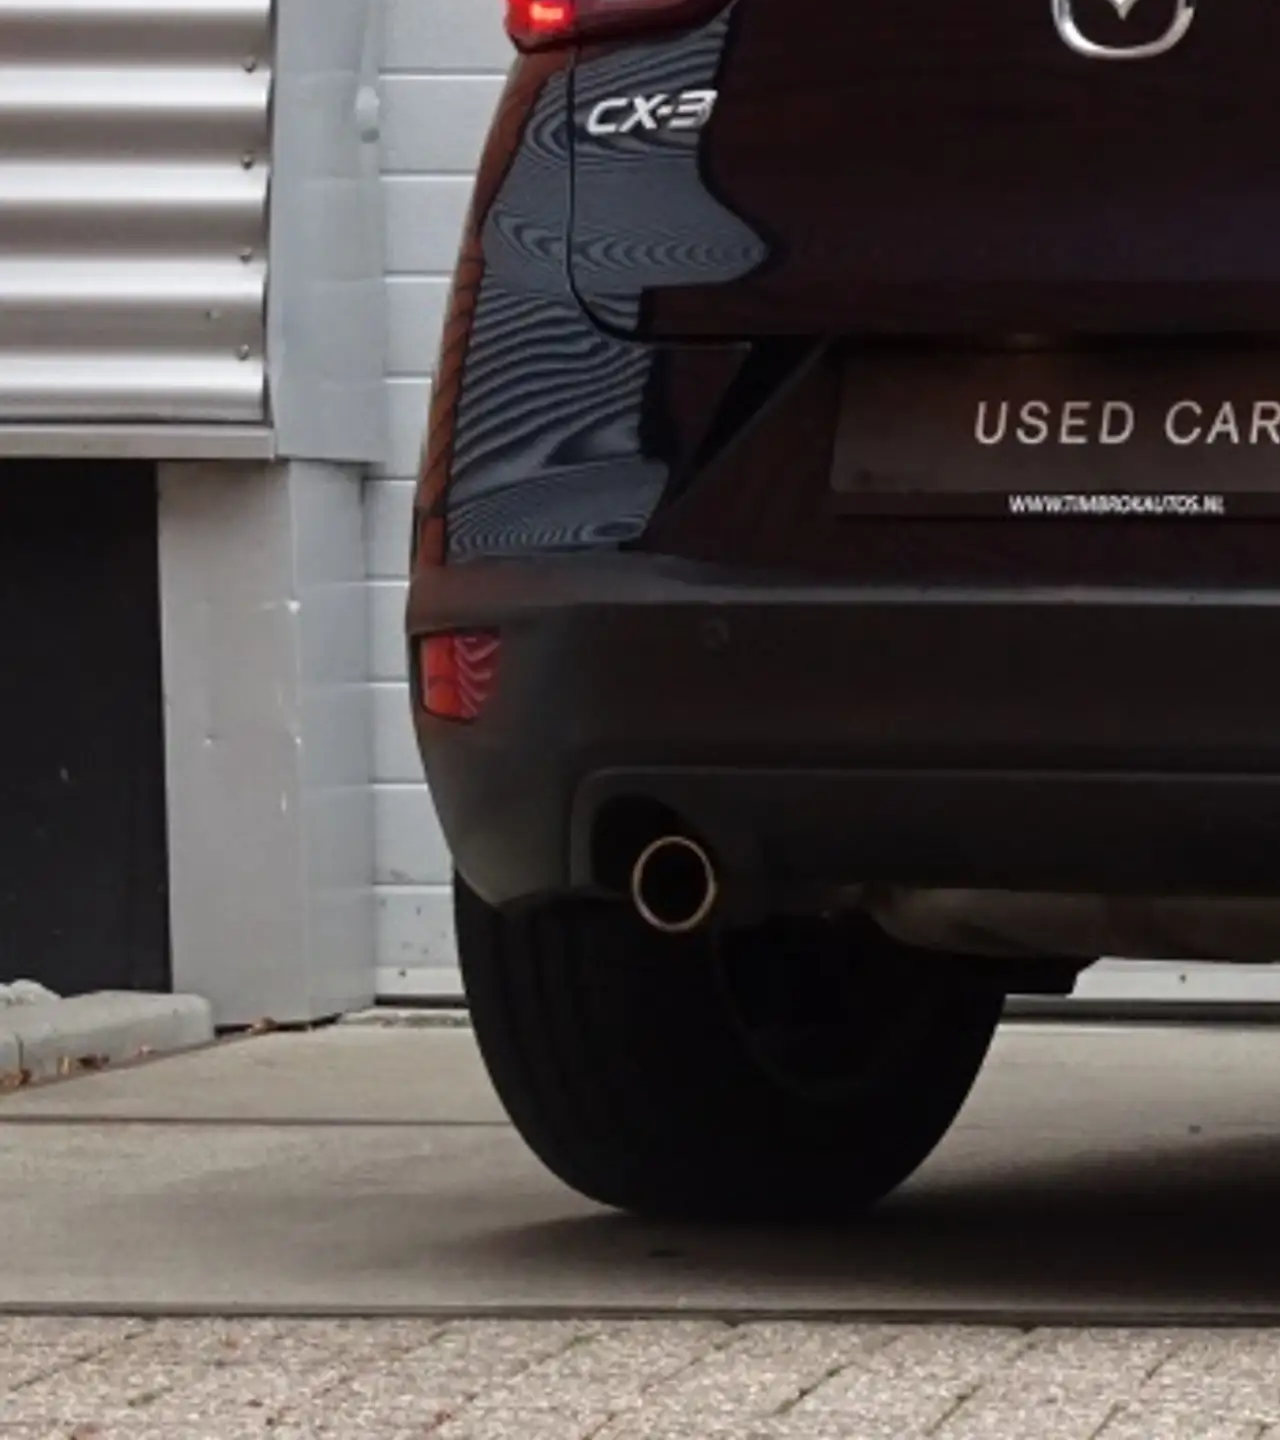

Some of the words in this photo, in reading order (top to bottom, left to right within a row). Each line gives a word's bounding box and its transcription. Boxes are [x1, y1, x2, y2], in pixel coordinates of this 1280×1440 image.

[586, 89, 718, 137] CX-3
[976, 401, 1134, 445] USED
[1008, 494, 1226, 515] WWW.TIMBROKAUTOS.NL
